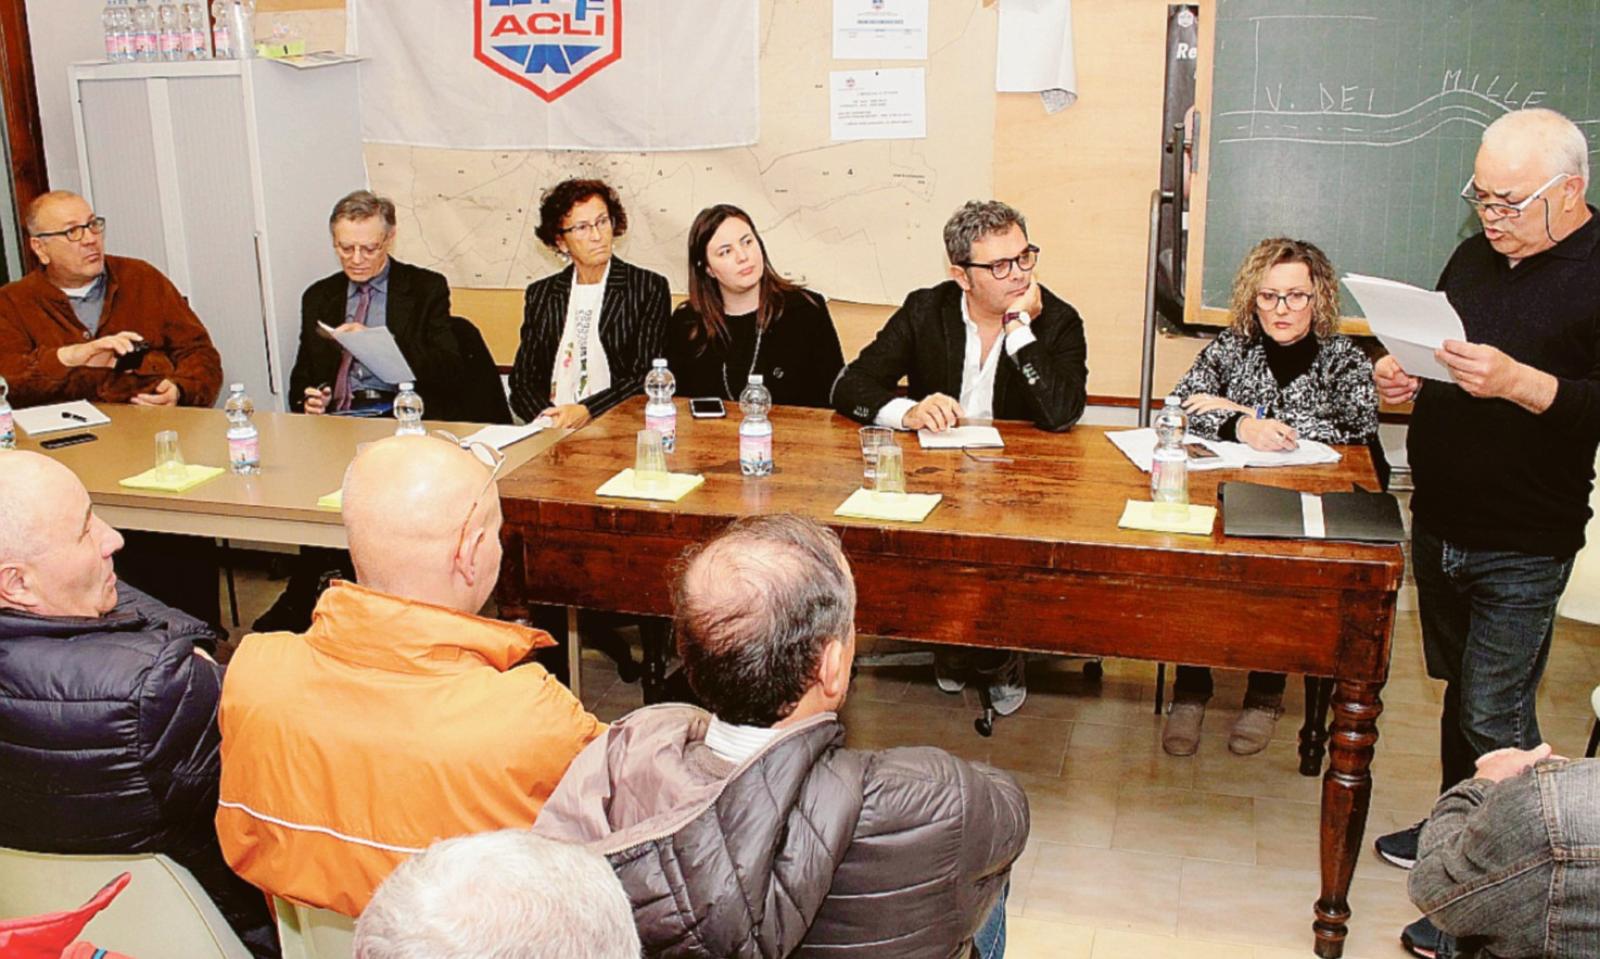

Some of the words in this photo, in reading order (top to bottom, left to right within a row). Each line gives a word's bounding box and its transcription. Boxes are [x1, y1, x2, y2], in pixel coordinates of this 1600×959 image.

[490, 13, 605, 37] ACLI
[1265, 83, 1295, 112] V.
[1319, 82, 1375, 112] DEI
